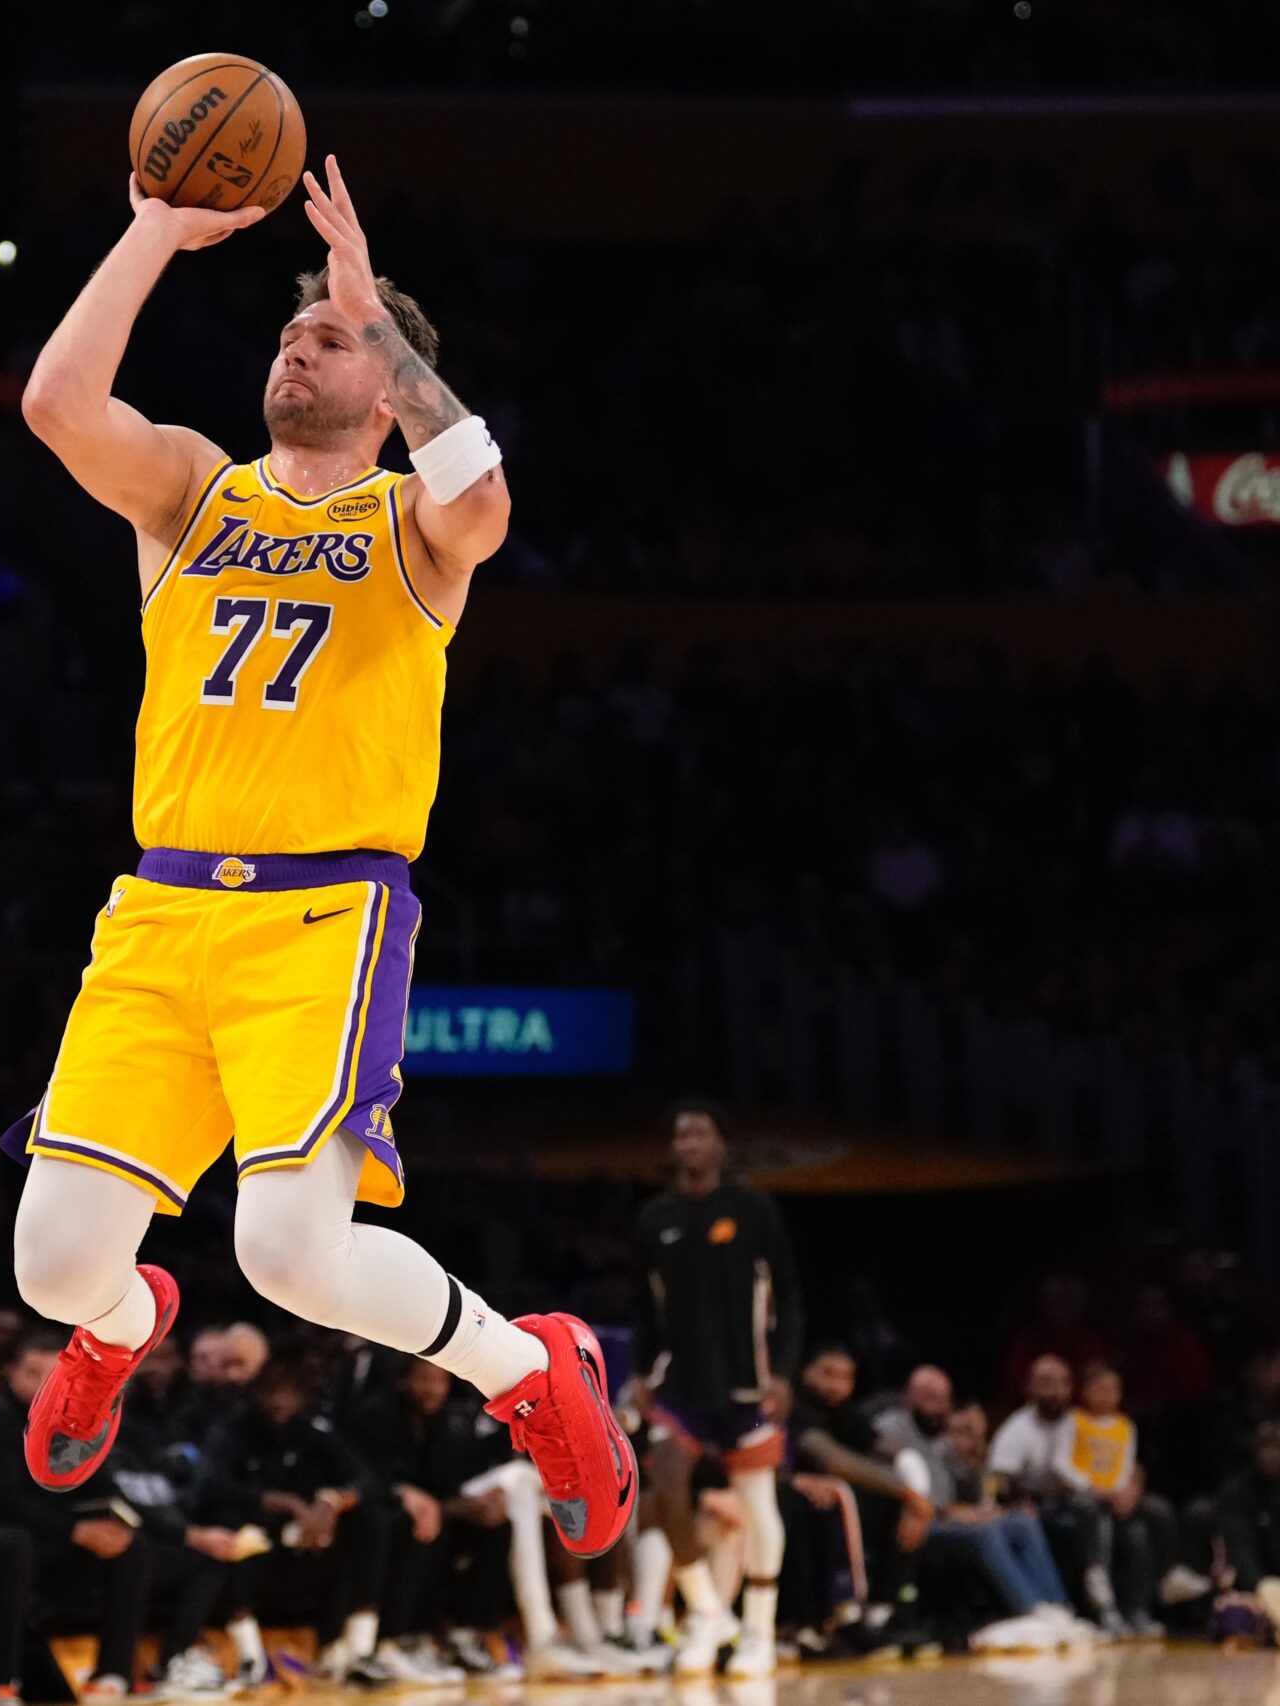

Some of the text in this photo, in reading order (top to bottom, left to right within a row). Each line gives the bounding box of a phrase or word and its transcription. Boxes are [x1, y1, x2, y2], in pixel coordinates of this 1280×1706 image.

[145, 87, 228, 182] Wilson
[332, 502, 377, 513] bibigo
[180, 515, 375, 583] LAKERS
[200, 596, 334, 711] 77
[213, 864, 255, 881] LAKERS
[404, 1006, 552, 1053] ULTRA
